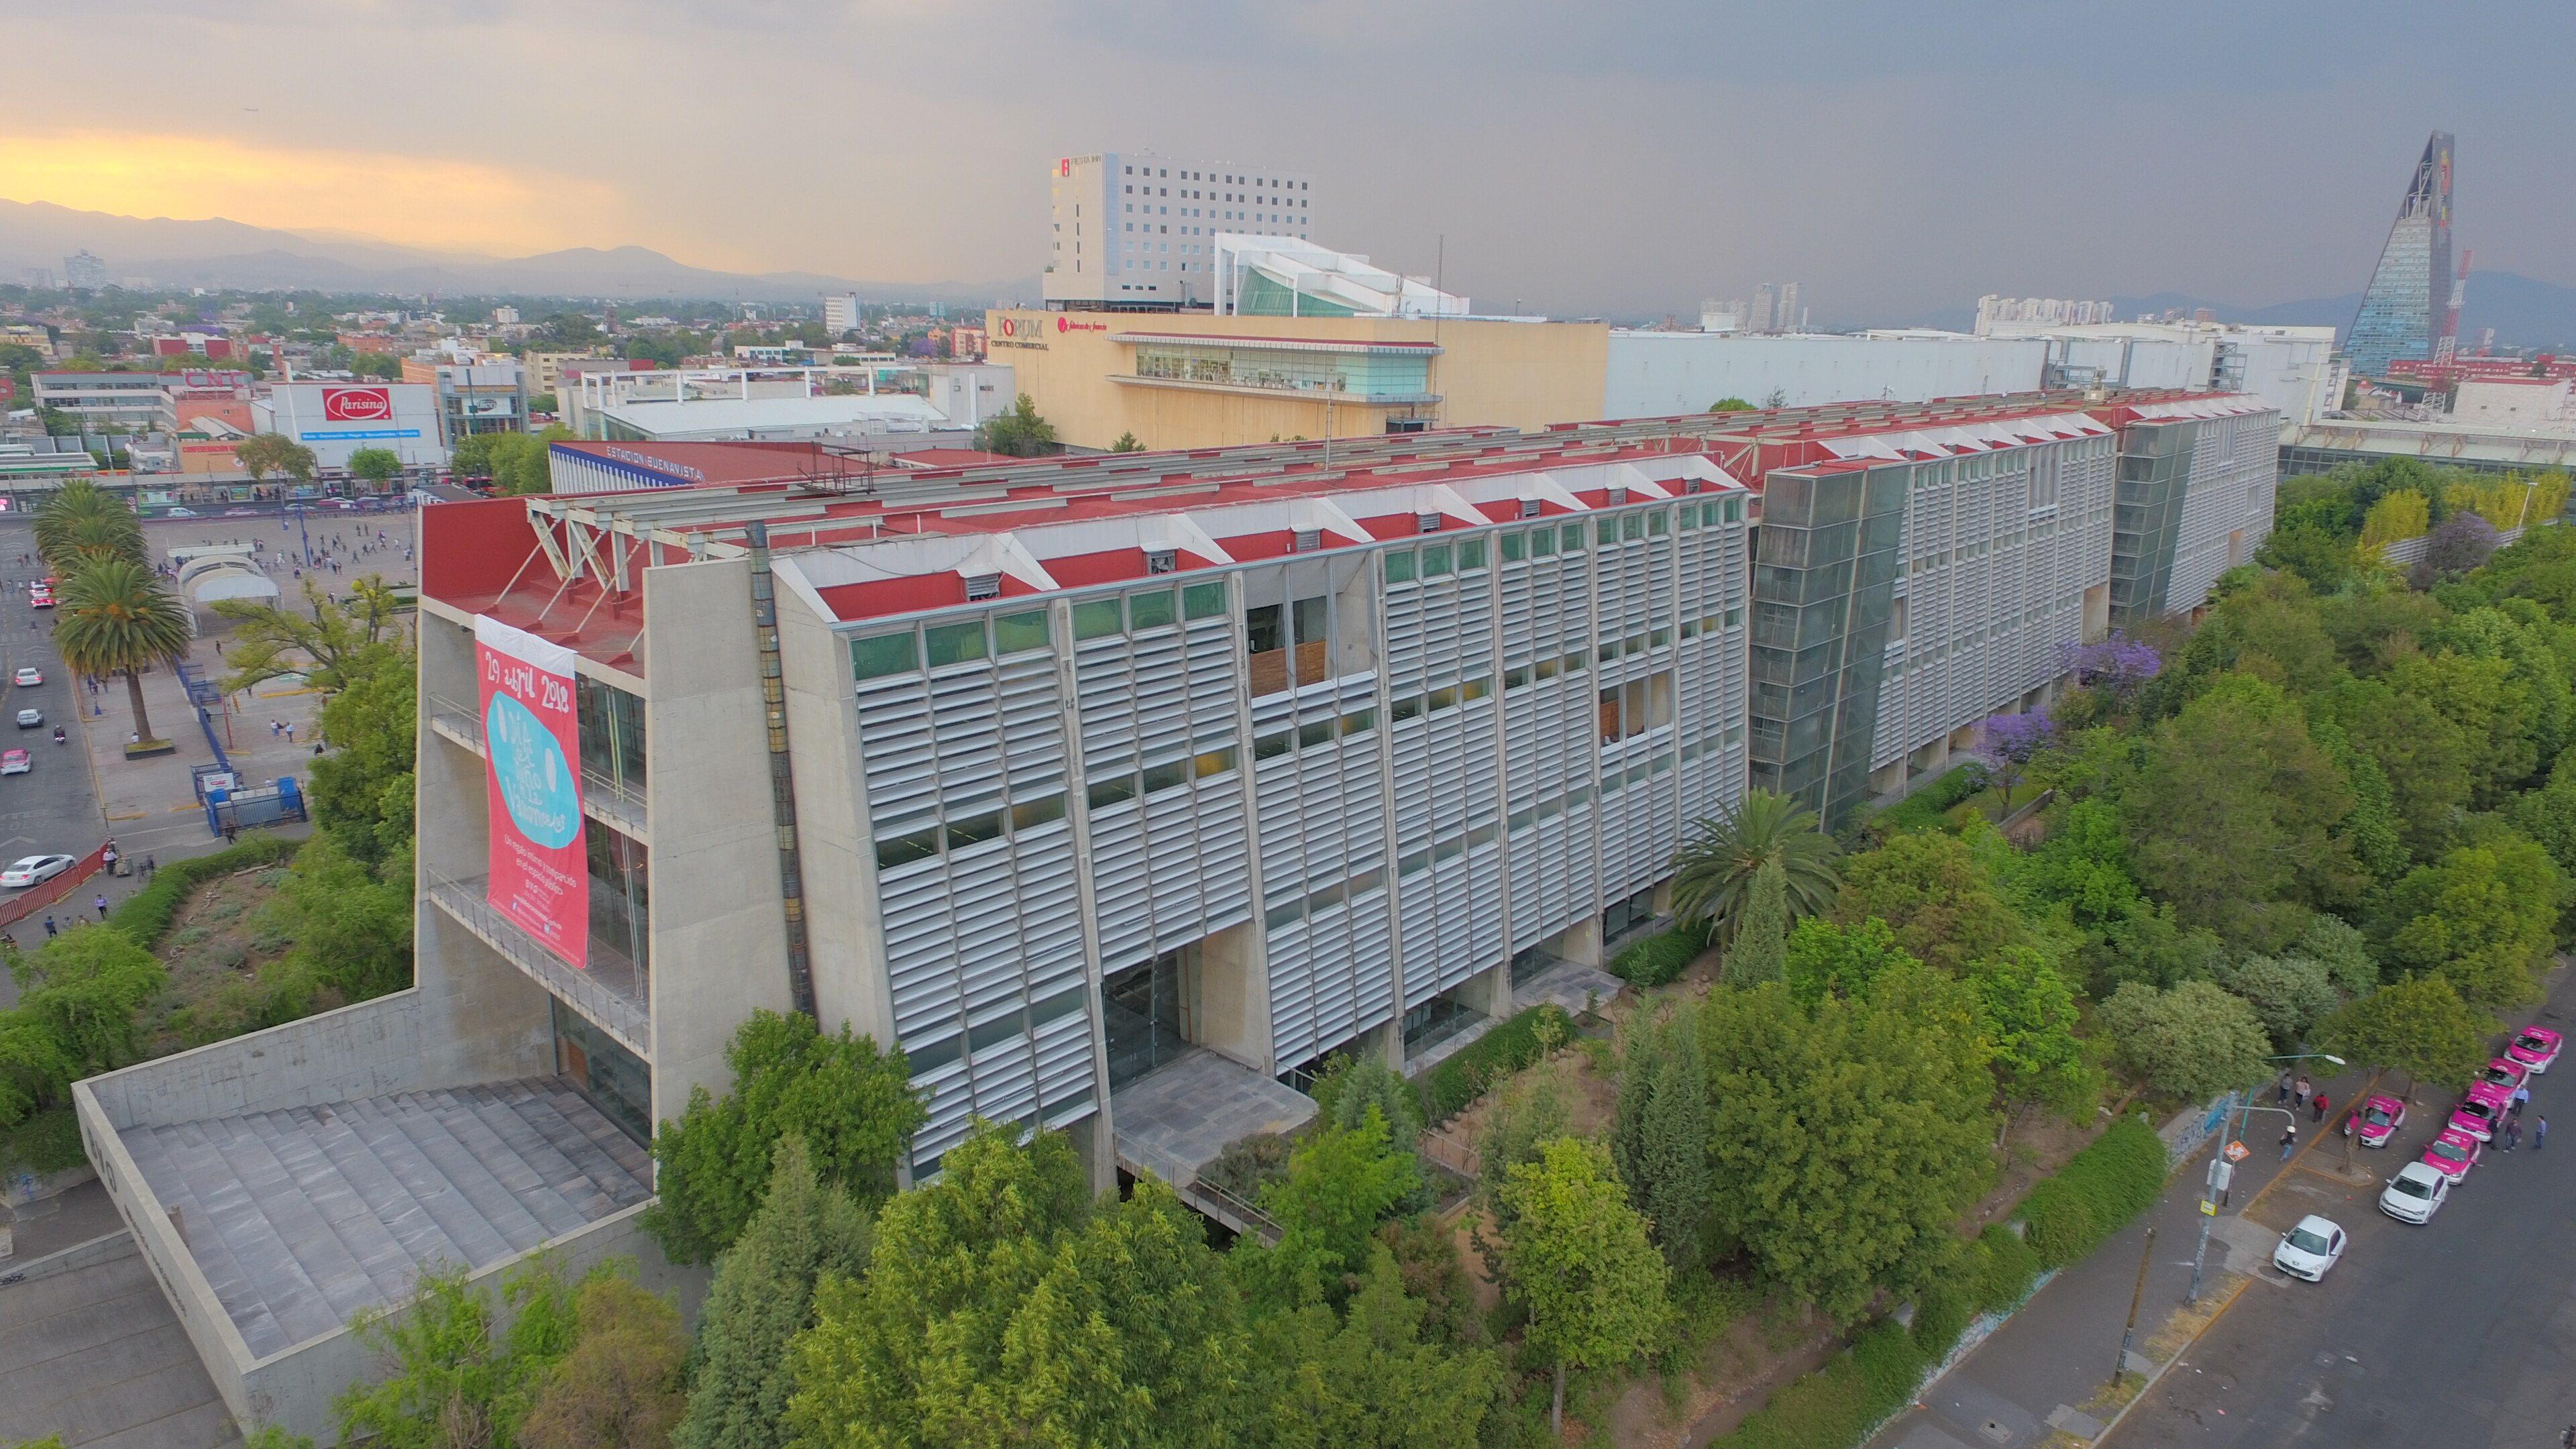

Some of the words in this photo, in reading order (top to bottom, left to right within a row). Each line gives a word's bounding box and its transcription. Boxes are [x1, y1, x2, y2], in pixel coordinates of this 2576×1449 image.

[997, 316, 1043, 340] FORUM
[991, 340, 1014, 348] CENTRO
[1015, 341, 1049, 351] COMERCIAL
[185, 372, 245, 389] CNC
[340, 396, 385, 411] Parisina
[647, 455, 704, 481] BUENAVISTA
[485, 651, 500, 684] 29
[504, 666, 535, 699] abril
[541, 675, 570, 713] 2018
